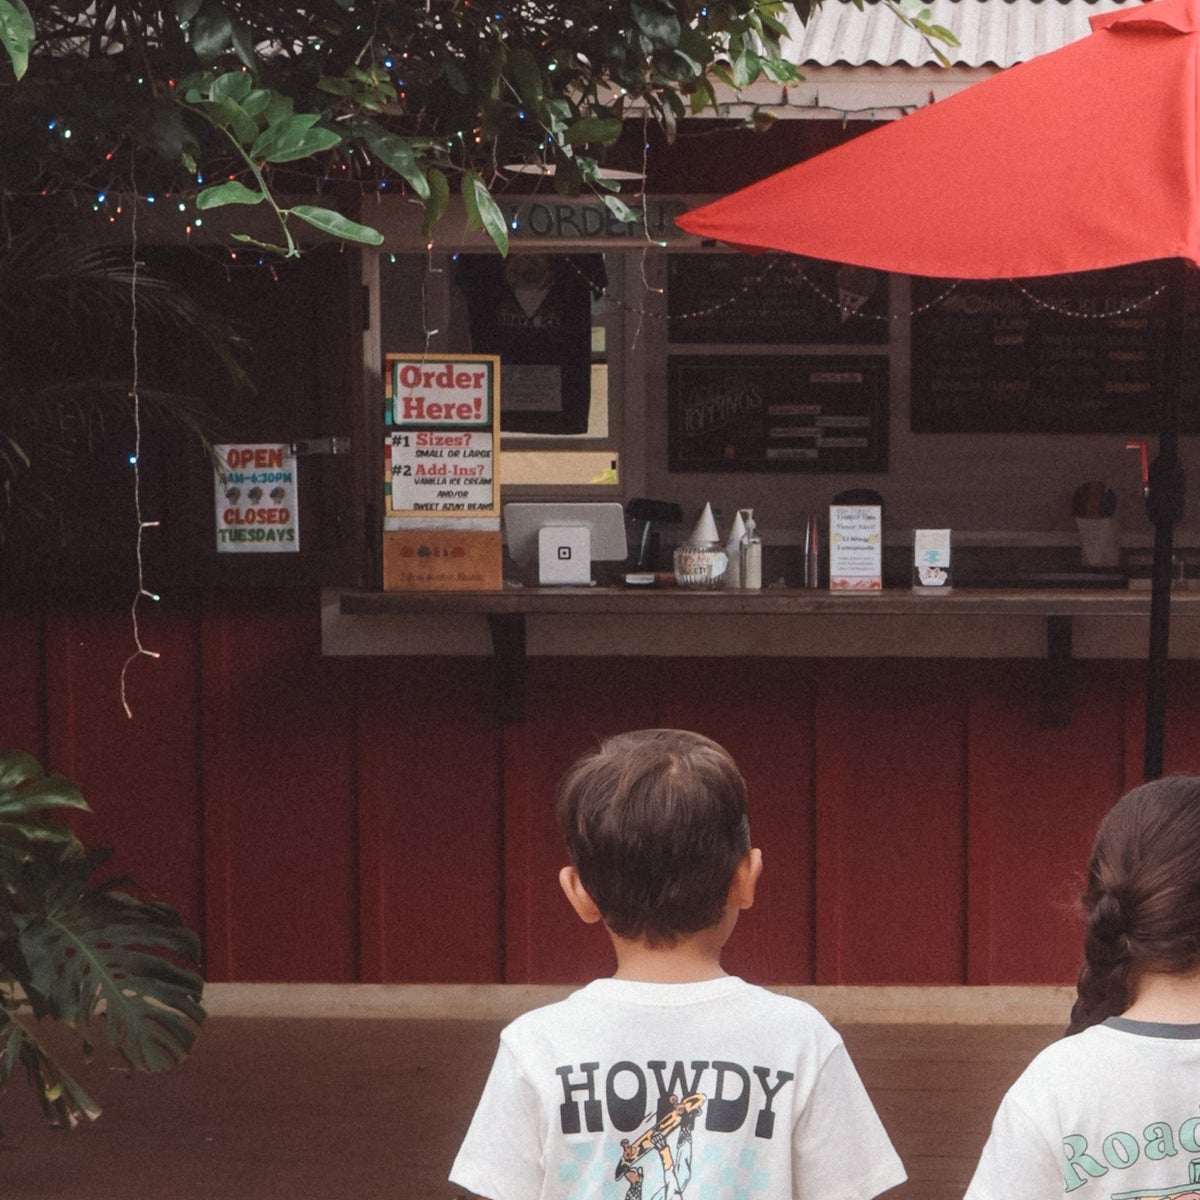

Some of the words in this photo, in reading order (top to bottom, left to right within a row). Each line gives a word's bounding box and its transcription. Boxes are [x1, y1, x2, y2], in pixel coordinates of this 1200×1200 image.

[400, 364, 485, 389] Order
[402, 397, 482, 420] Here!
[392, 435, 410, 448] #1
[416, 432, 472, 447] Sizes?
[227, 448, 283, 469] OPEN
[415, 450, 444, 458] SMALL
[447, 450, 460, 458] OR
[463, 450, 491, 458] LARGE
[392, 465, 412, 477] #2
[415, 464, 485, 477] Add-Ins?
[414, 478, 447, 486] VANILLA
[449, 478, 461, 486] ICE
[463, 478, 492, 486] CREAM
[437, 490, 469, 498] AND/OR
[413, 503, 439, 511] SWEET
[223, 507, 290, 526] CLOSED
[219, 528, 295, 543] TUESDAYS
[555, 1060, 794, 1140] HOWDY
